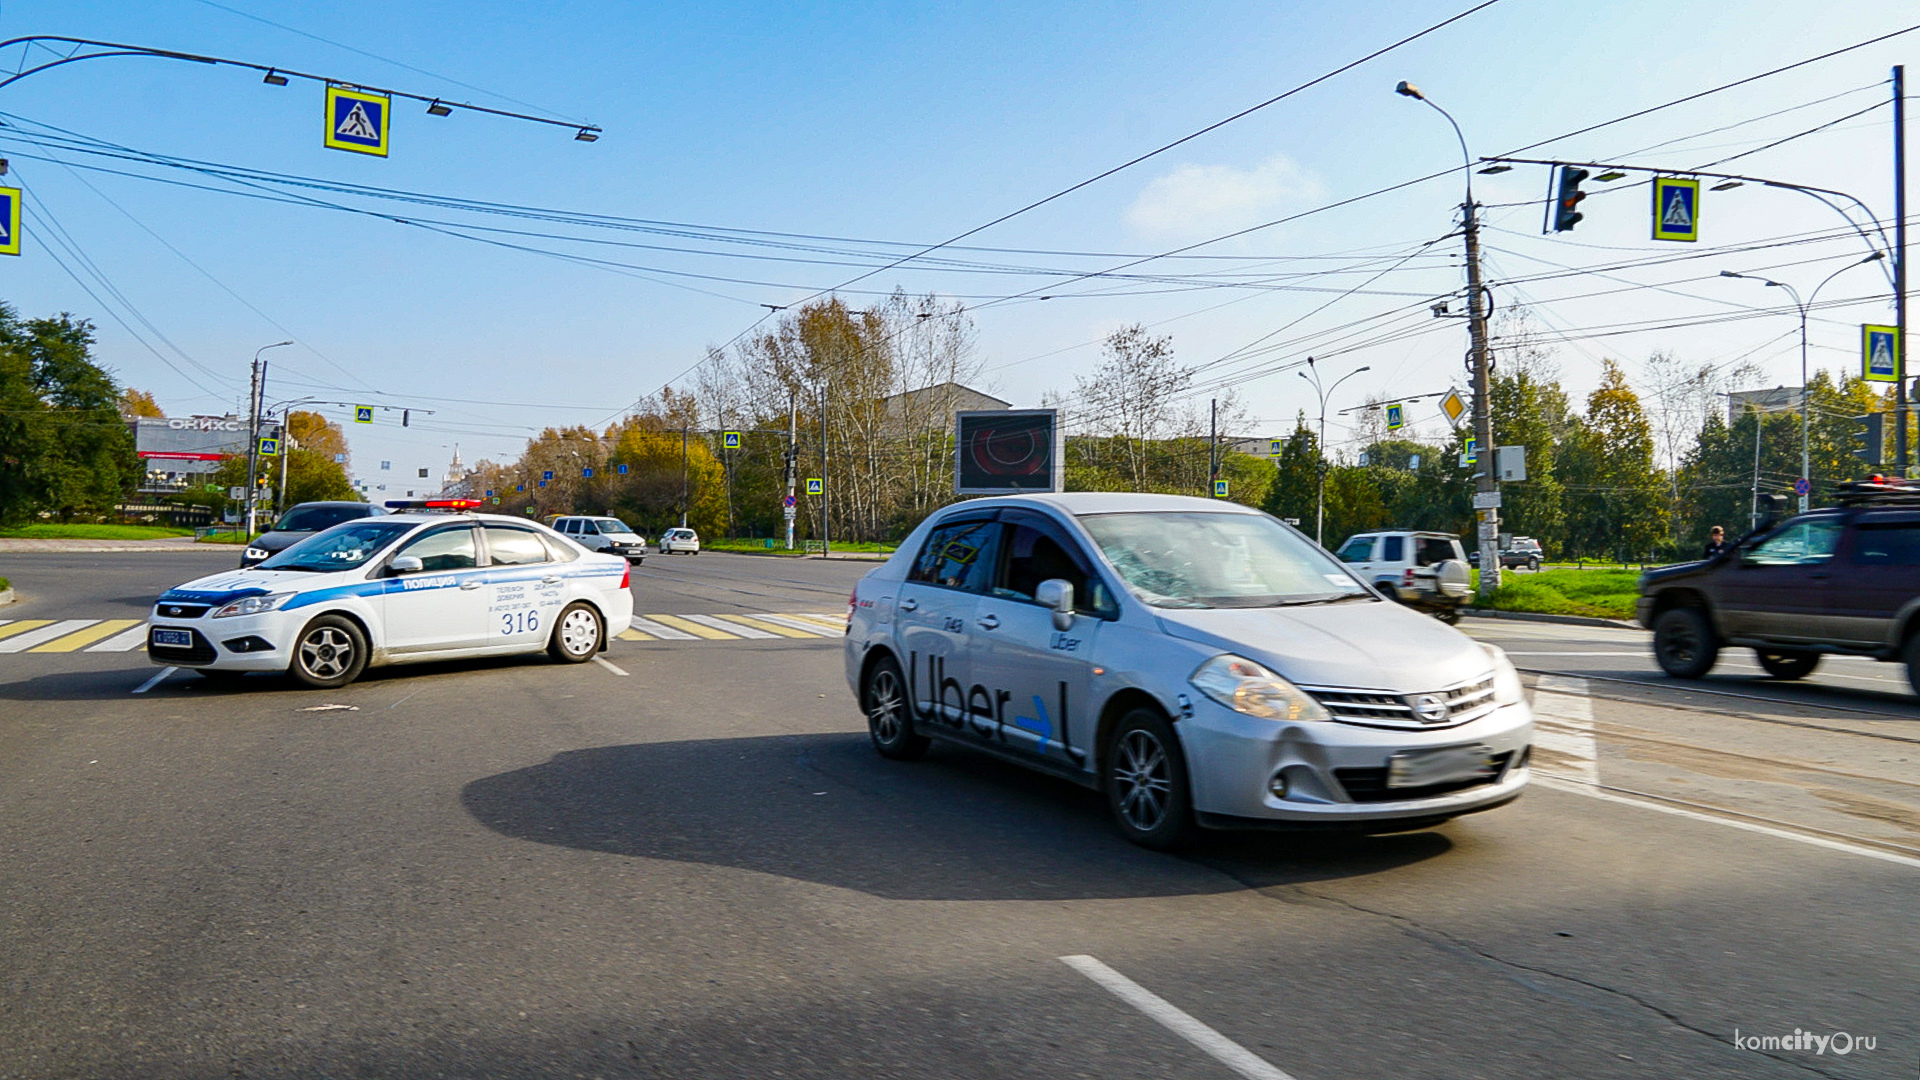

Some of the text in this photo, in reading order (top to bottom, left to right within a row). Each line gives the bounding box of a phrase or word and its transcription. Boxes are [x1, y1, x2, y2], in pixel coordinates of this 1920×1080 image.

[403, 576, 457, 590] ПОЛИЦИЯ
[502, 610, 538, 635] 316
[1050, 632, 1082, 652] Uber
[910, 650, 1012, 742] Uber
